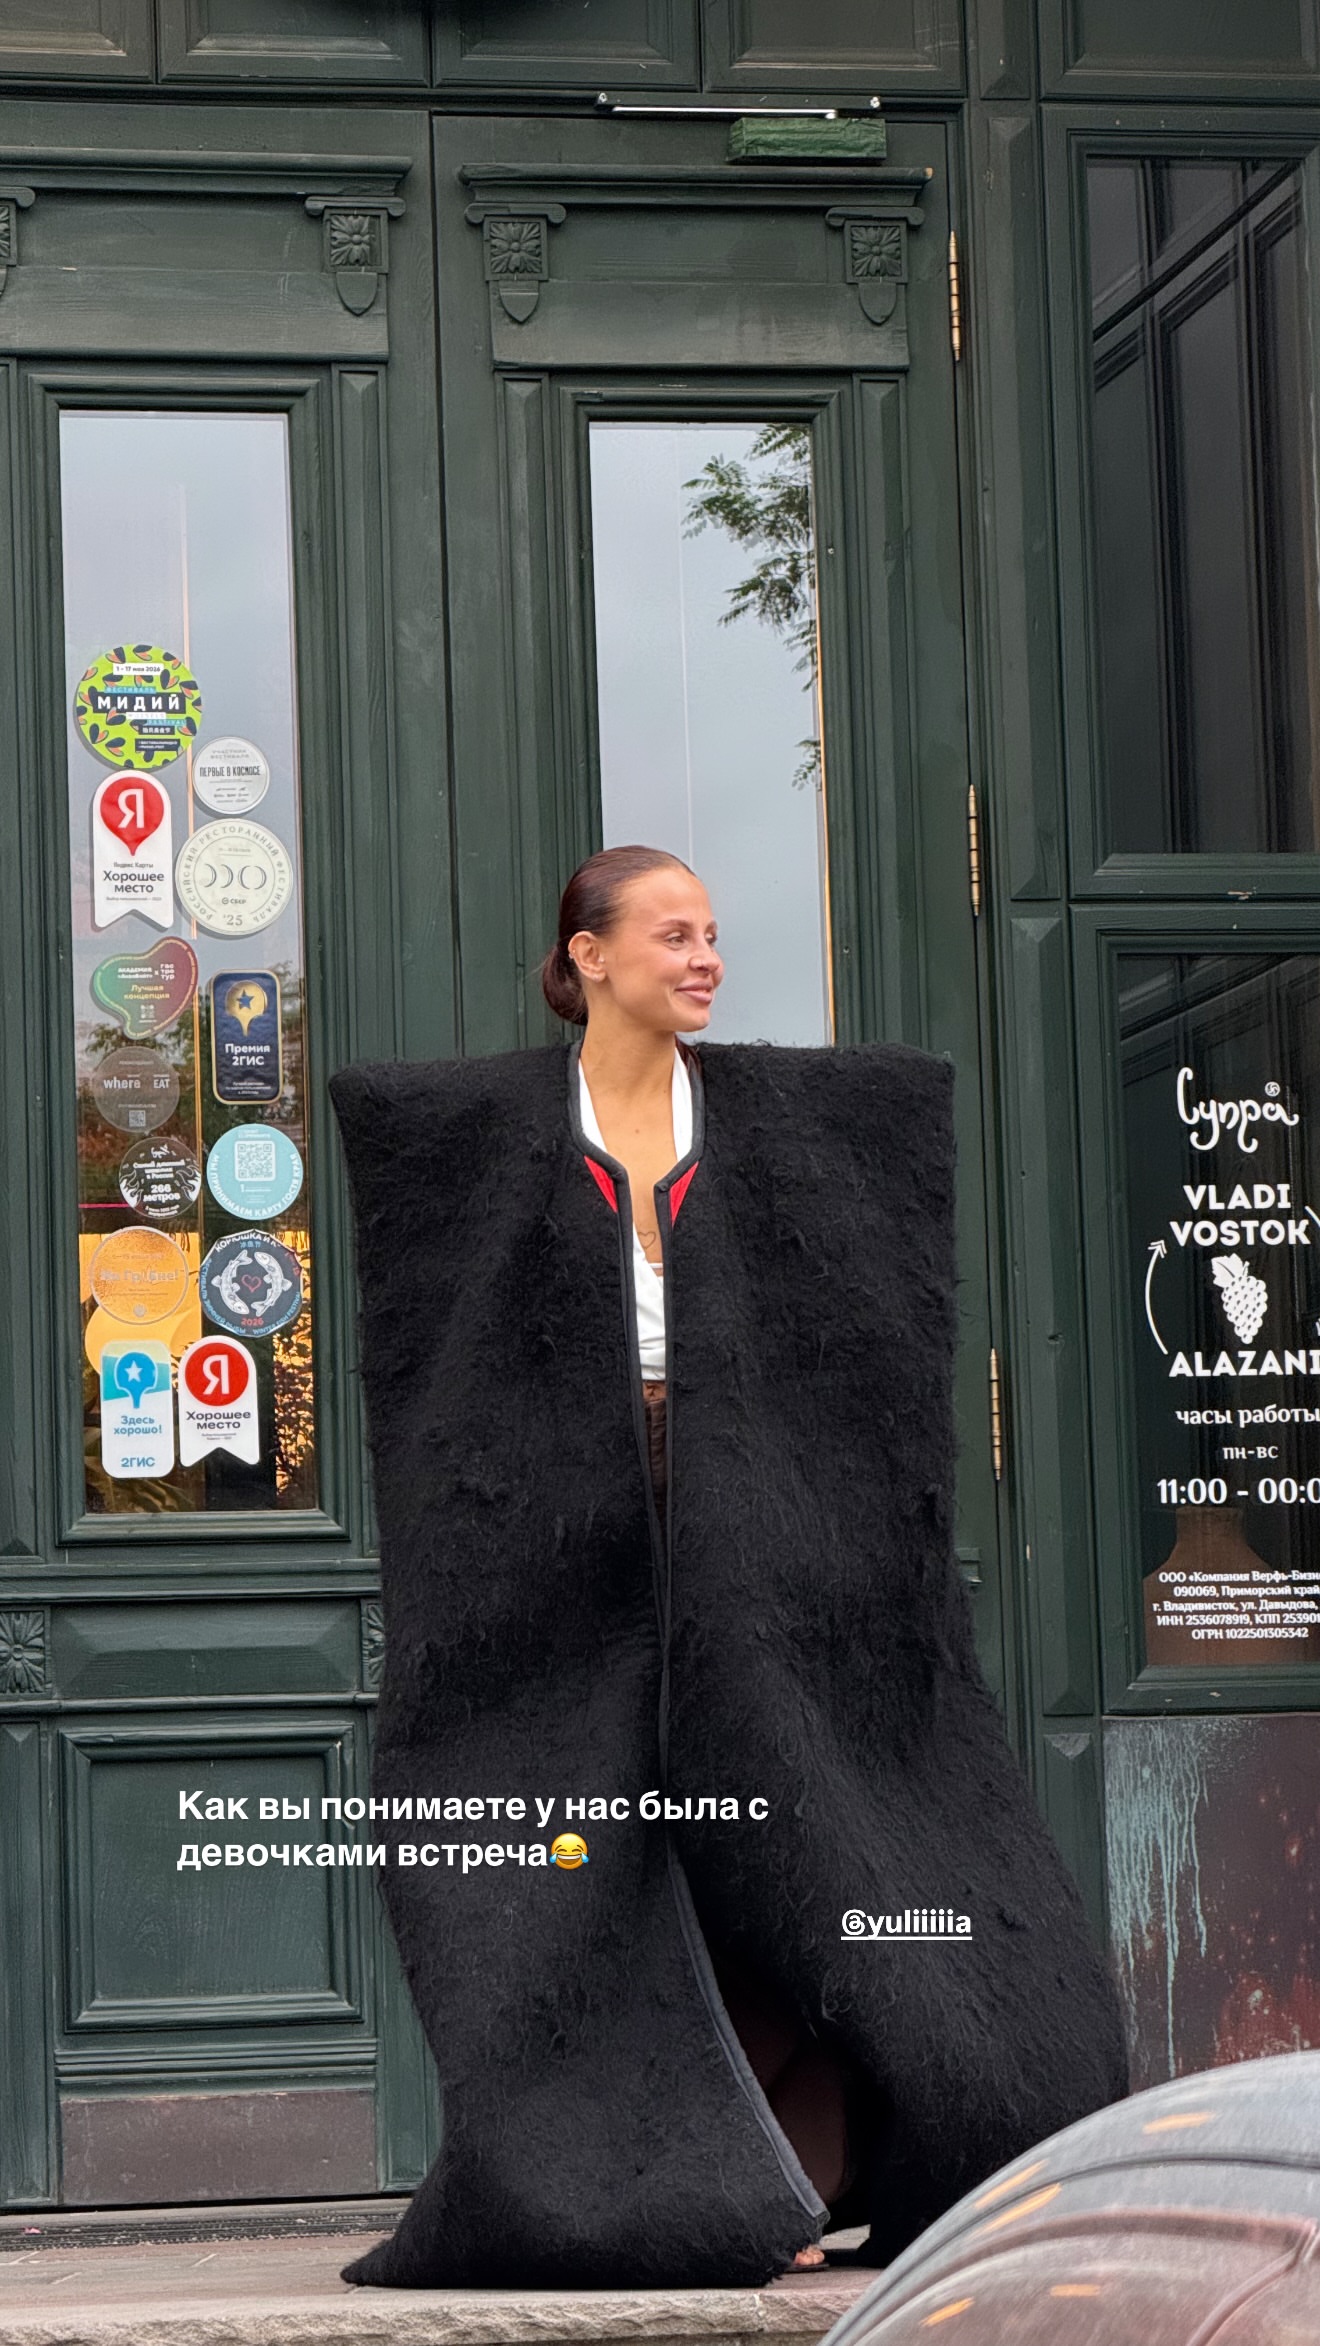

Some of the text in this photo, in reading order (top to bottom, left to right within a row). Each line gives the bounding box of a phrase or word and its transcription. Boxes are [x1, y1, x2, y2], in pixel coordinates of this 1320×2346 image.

[97, 694, 180, 712] МИДИЙ
[199, 765, 261, 777] ПЕРВЫЕ В КОСМОСЕ
[117, 789, 144, 829] Я
[103, 870, 165, 883] Хорошее
[183, 847, 213, 920] РОССИЙСКИЙ
[199, 825, 280, 856] РЕСТОРАННЫЙ
[114, 884, 154, 893] место
[131, 984, 164, 992] Лучшая
[224, 1043, 271, 1055] Премия
[231, 1056, 265, 1066] 2ГИС
[103, 1076, 170, 1089] where EAT
[143, 1192, 181, 1203] метров
[210, 1174, 253, 1217] ПРИНИМАЕМ
[254, 1202, 283, 1217] КАРТУ
[1183, 1183, 1292, 1211] VLADI
[1169, 1219, 1311, 1247] VOSTOK
[214, 1233, 262, 1253] КОРЮШКА
[241, 1318, 264, 1326] 2026
[1168, 1349, 1320, 1377] ALAZANI
[202, 1354, 231, 1395] Я
[120, 1415, 155, 1427] Здесь
[186, 1411, 251, 1421] Хорошее
[1175, 1404, 1320, 1428] часы работы
[113, 1424, 162, 1436] хорошо!
[196, 1421, 241, 1430] место
[1222, 1446, 1279, 1460] пн-вс
[120, 1457, 155, 1467] 2ГИС
[1156, 1477, 1228, 1505] 11:00
[1158, 1572, 1187, 1584] ООО
[1189, 1571, 1250, 1583] «Компания
[1221, 1584, 1292, 1598] Приморский
[1152, 1603, 1162, 1612] г.
[1240, 1603, 1258, 1613] ул.
[1259, 1600, 1319, 1612] Давыдова,
[1156, 1615, 1184, 1627] ИНН
[1254, 1613, 1281, 1625] КПП
[1191, 1628, 1224, 1640] ОГРН
